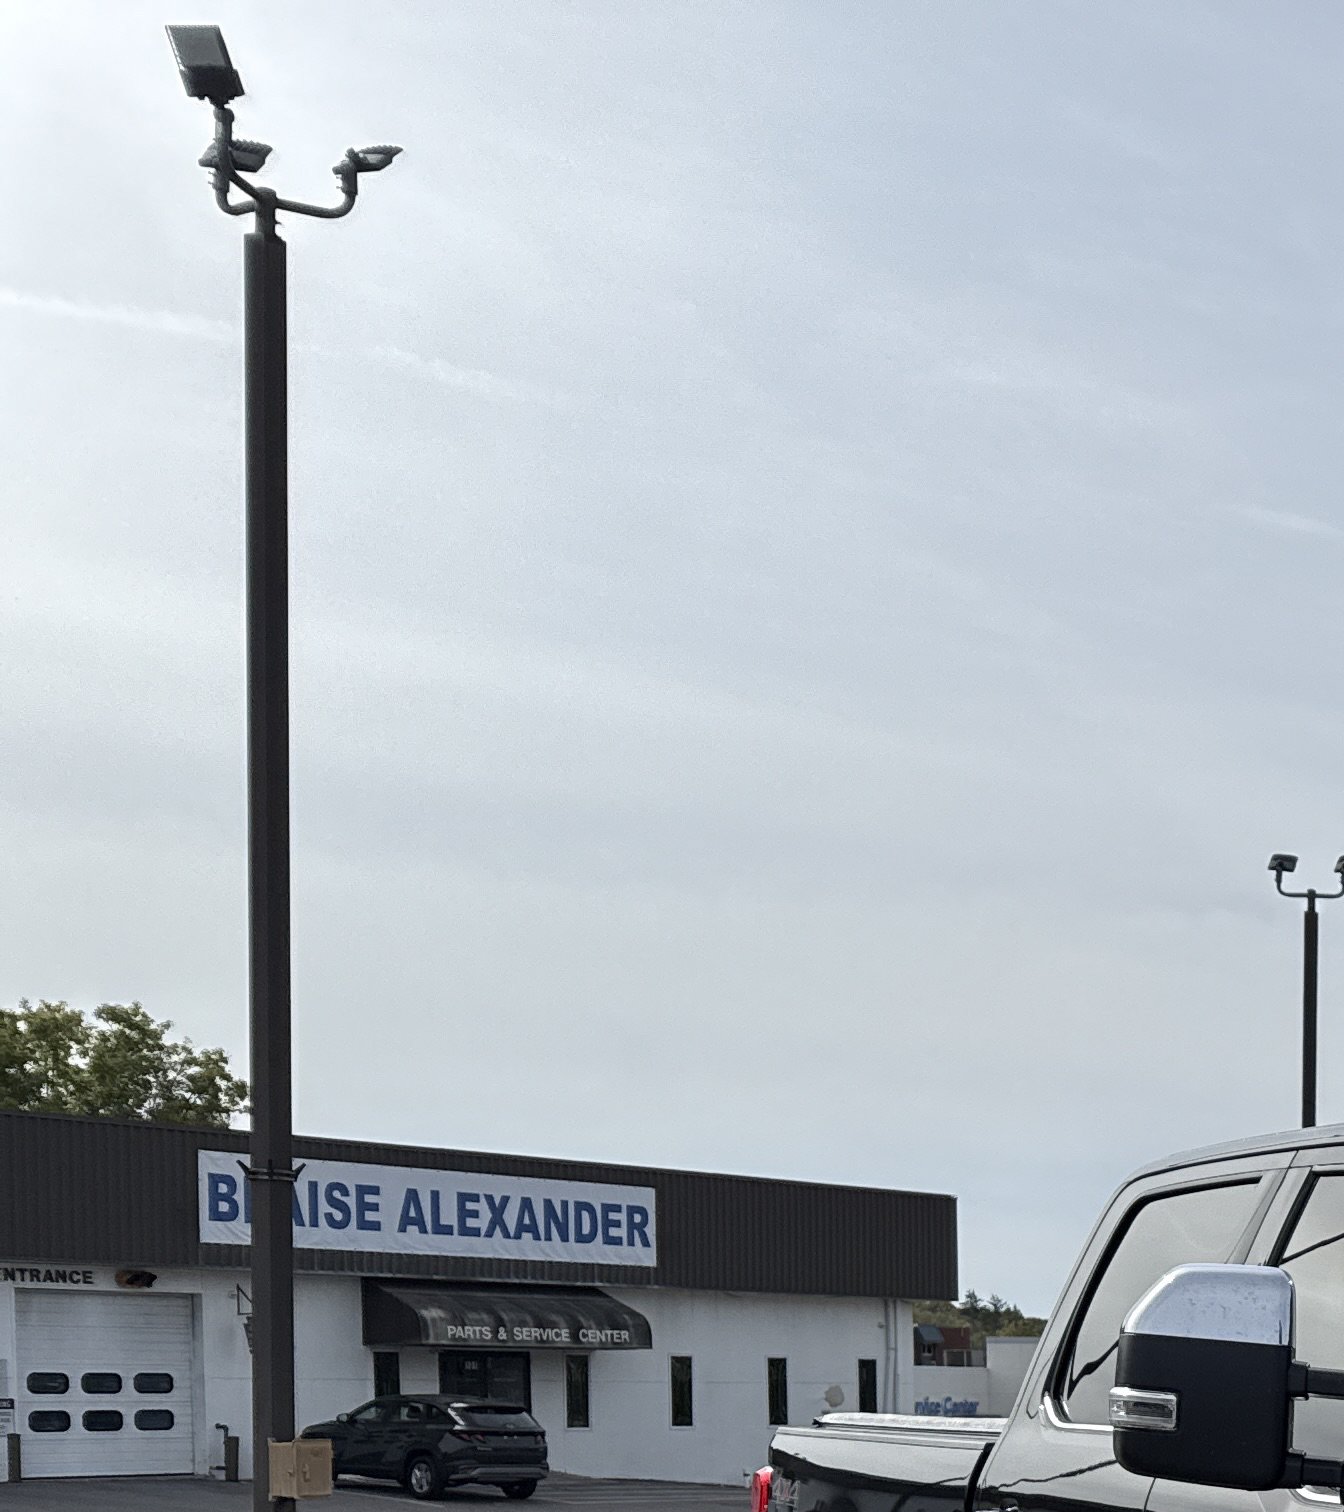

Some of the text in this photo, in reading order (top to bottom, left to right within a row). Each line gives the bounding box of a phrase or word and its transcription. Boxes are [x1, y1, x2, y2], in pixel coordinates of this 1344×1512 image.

[208, 1172, 652, 1248] BISE ALEXANDER
[0, 1267, 94, 1285] NTRANCE
[447, 1325, 630, 1344] PARTS & SERVICE CENTER
